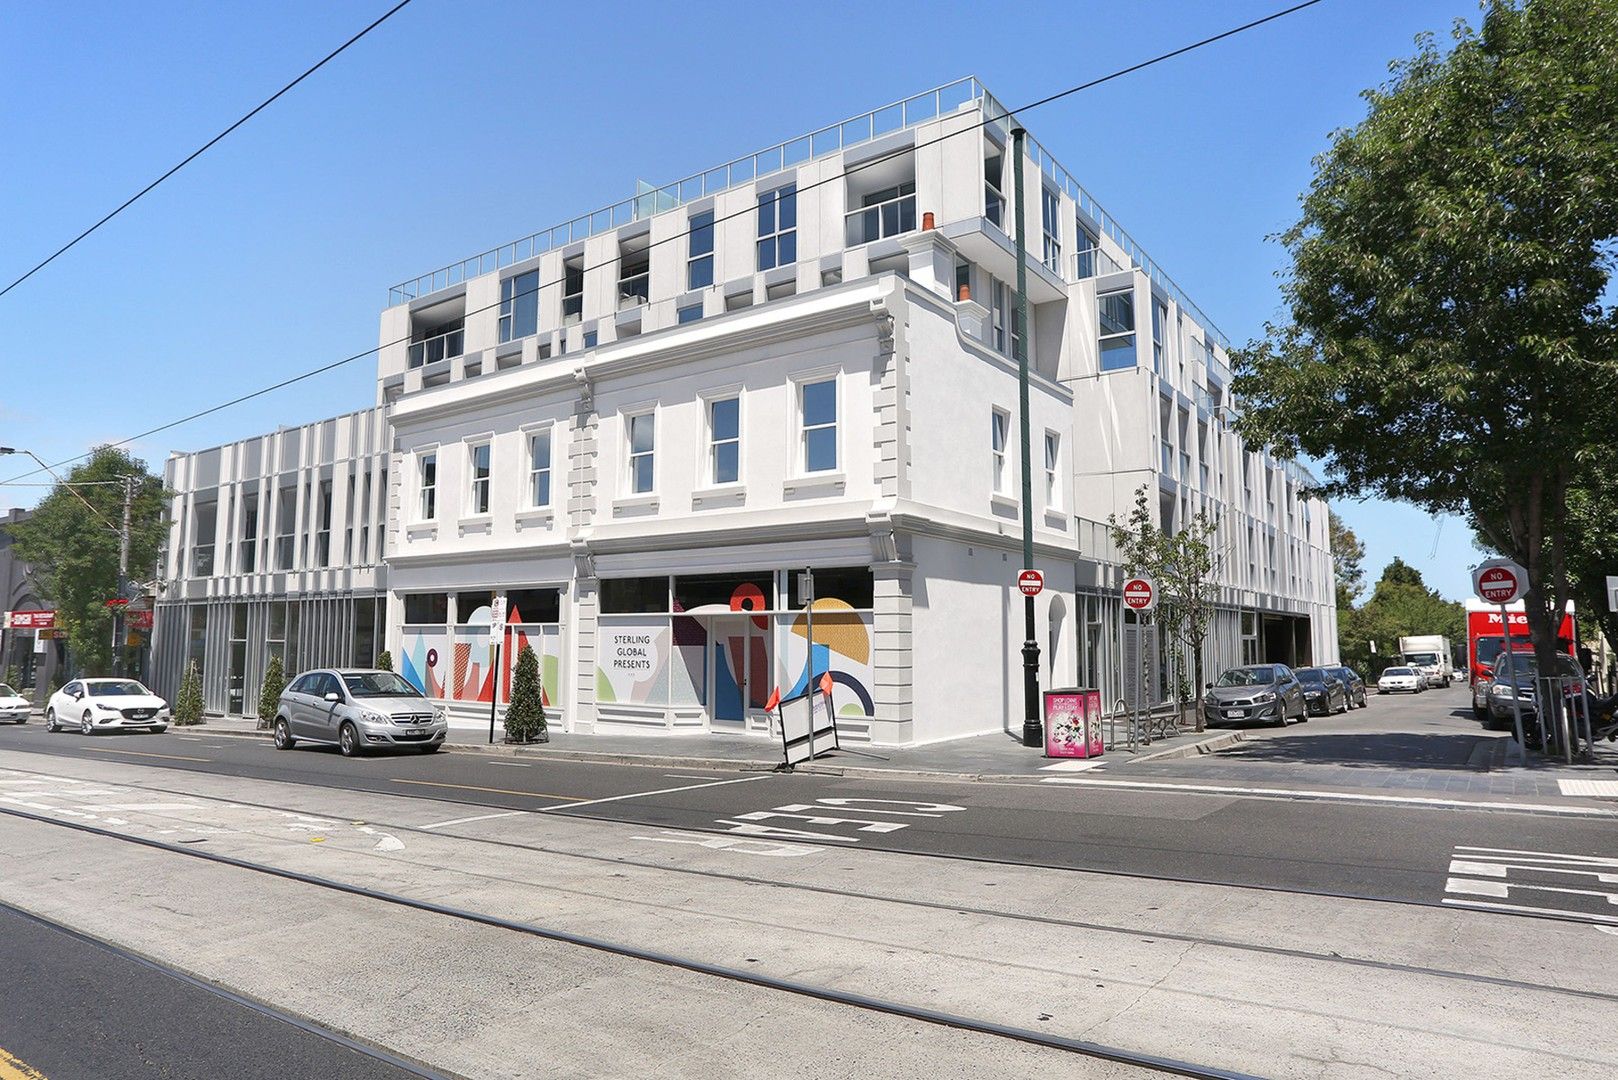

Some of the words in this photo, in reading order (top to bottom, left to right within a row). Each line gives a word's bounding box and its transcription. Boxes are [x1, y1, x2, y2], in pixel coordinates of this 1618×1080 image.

[1490, 572, 1503, 580] NO
[1485, 589, 1512, 599] ENTRY
[1127, 597, 1148, 605] ENTRY
[614, 635, 651, 644] STERLING
[617, 647, 647, 657] GLOBAL
[613, 659, 651, 669] PRESENTS
[629, 798, 967, 857] CLEAR
